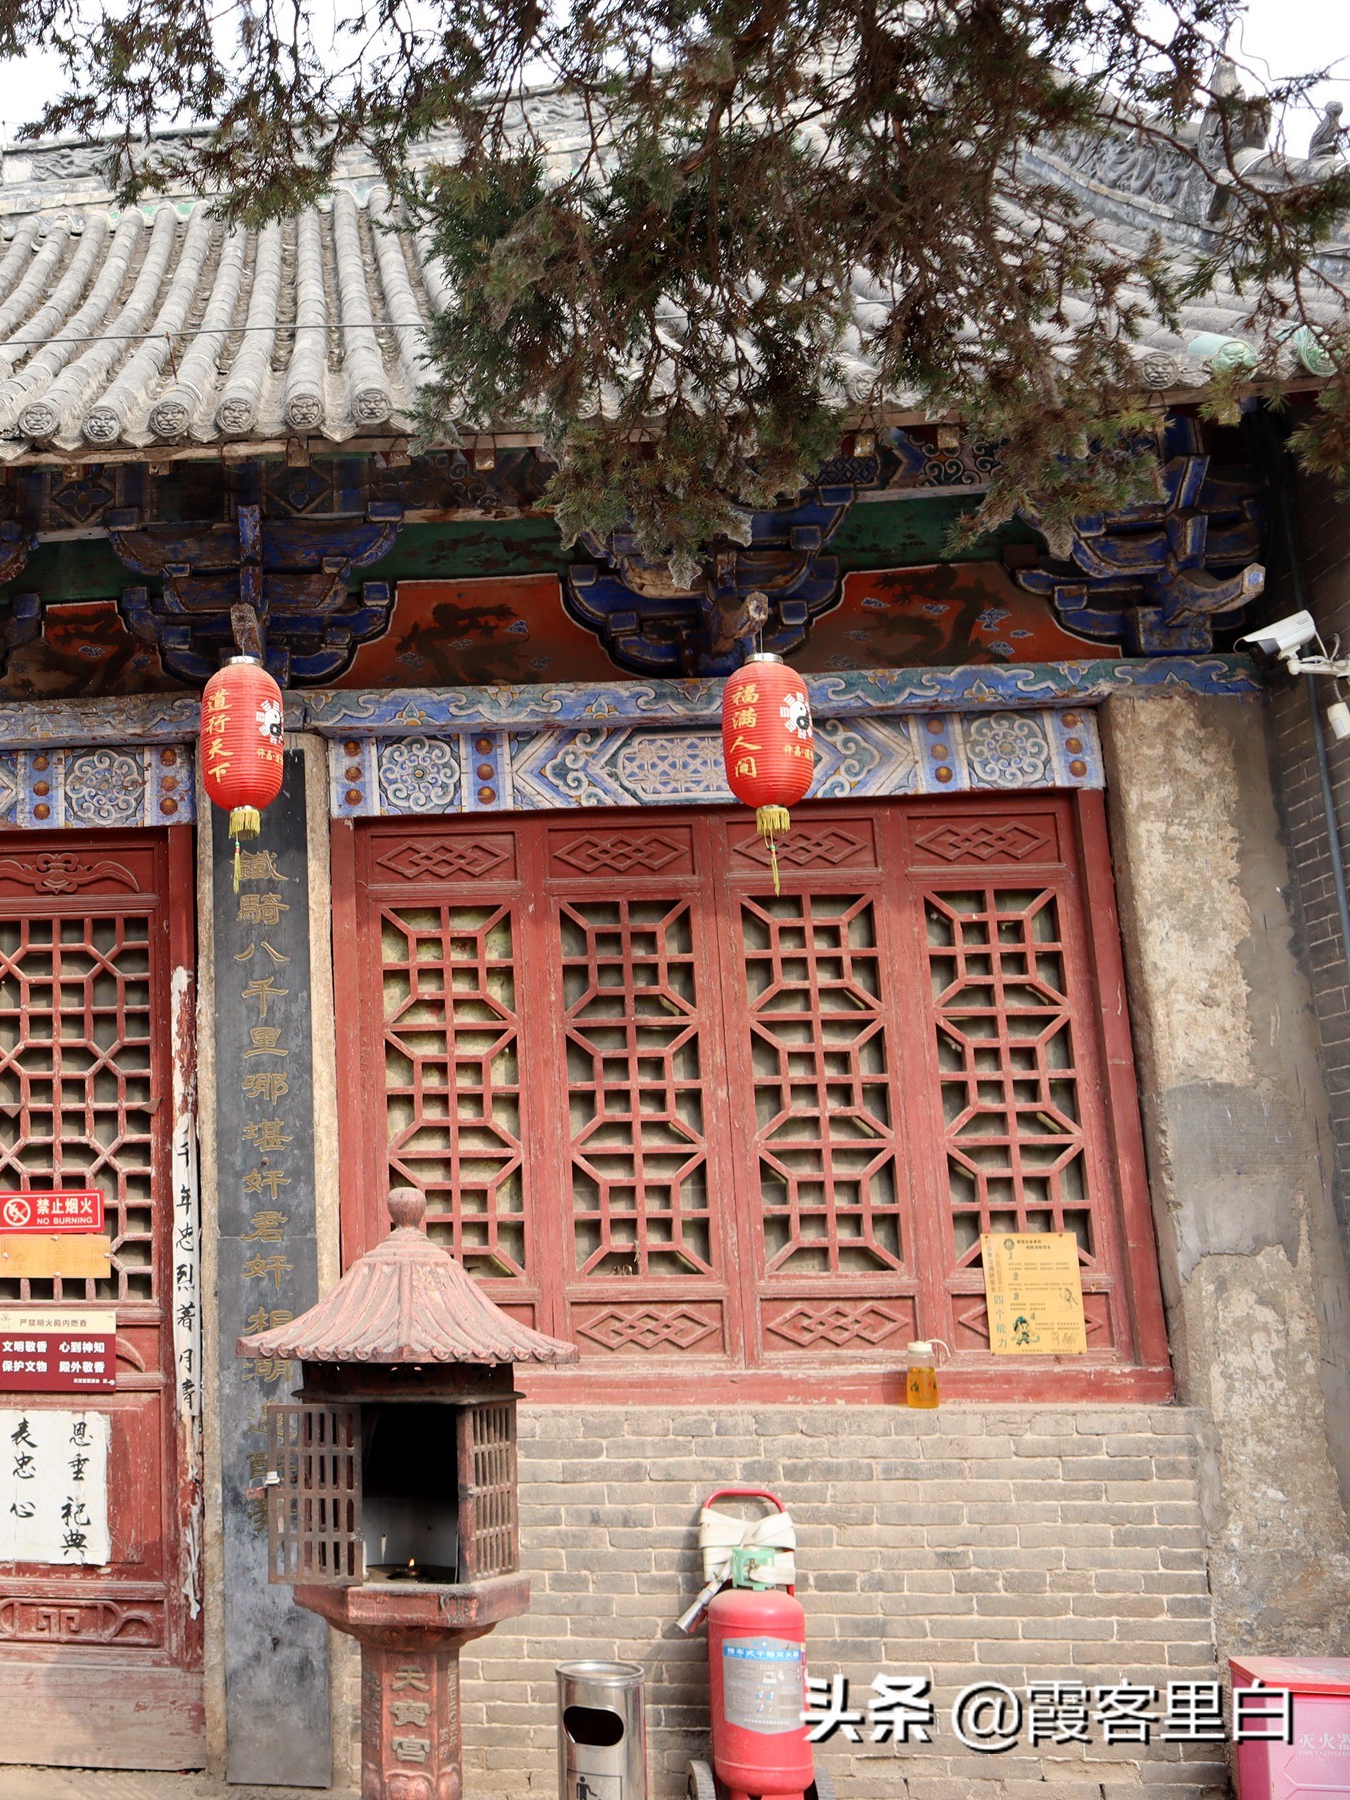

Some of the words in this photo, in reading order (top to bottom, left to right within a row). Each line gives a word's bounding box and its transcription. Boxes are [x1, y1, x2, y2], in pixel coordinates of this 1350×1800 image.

[206, 688, 234, 784] 道行天下
[729, 684, 762, 778] 福满人间
[36, 1198, 94, 1214] 禁止烟火
[36, 1217, 50, 1225] NO
[53, 1216, 94, 1225] BURNING
[2, 1340, 48, 1353] 文明敬香
[59, 1341, 105, 1353] 心到神知
[2, 1360, 48, 1372] 保护文物
[59, 1361, 105, 1373] 殿外敬香
[10, 1417, 38, 1519] 表忠心
[59, 1421, 94, 1559] 恩垂祀典
